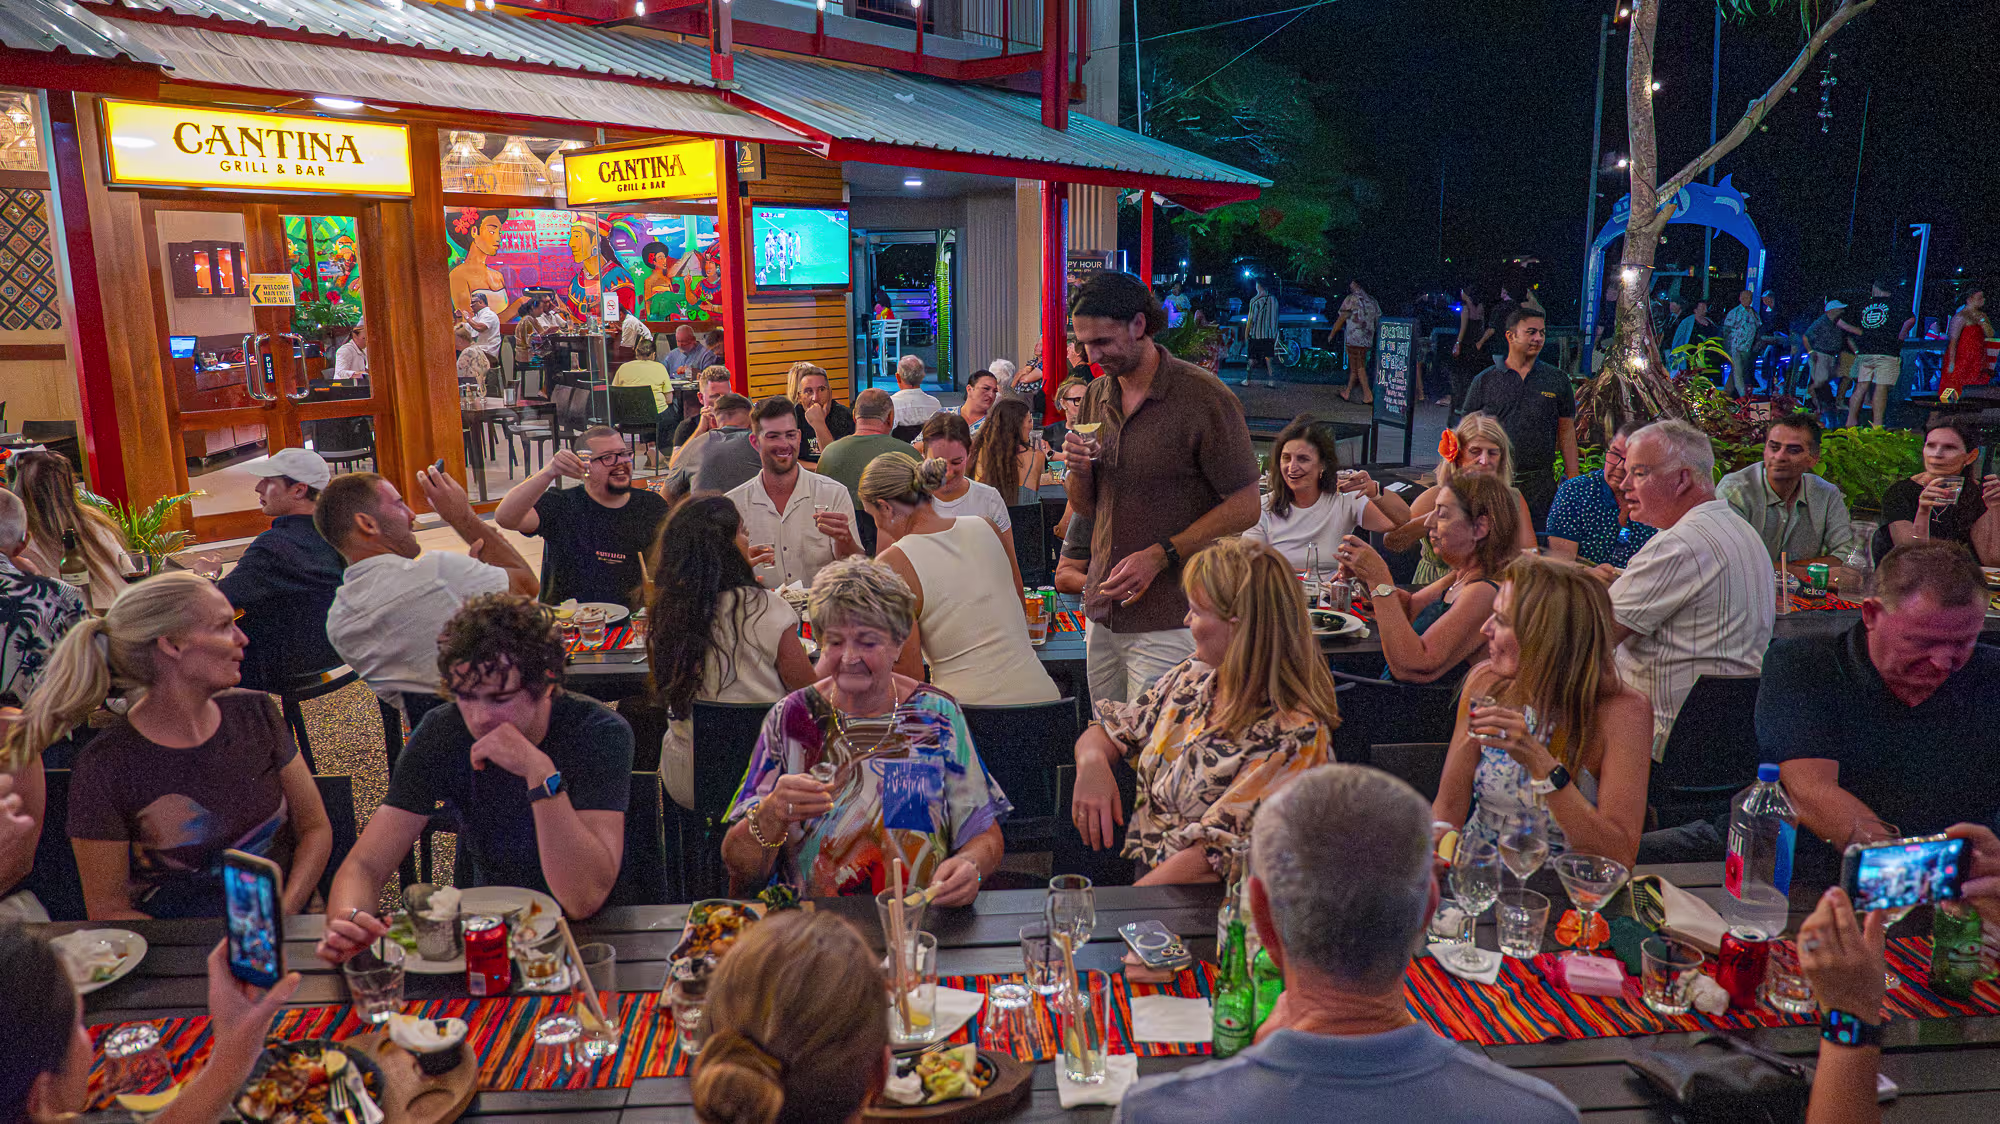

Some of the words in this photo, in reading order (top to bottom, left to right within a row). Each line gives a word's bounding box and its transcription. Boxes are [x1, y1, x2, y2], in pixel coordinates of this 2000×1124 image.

[172, 121, 364, 164] CANTINA
[220, 160, 268, 174] GRILL
[277, 163, 286, 174] &
[295, 164, 326, 177] BAR
[598, 154, 687, 183] CANTINA
[616, 183, 639, 192] GRILL
[641, 182, 647, 190] &
[650, 180, 666, 190] BAR
[1079, 261, 1103, 269] HOUR
[265, 356, 274, 380] PUSH
